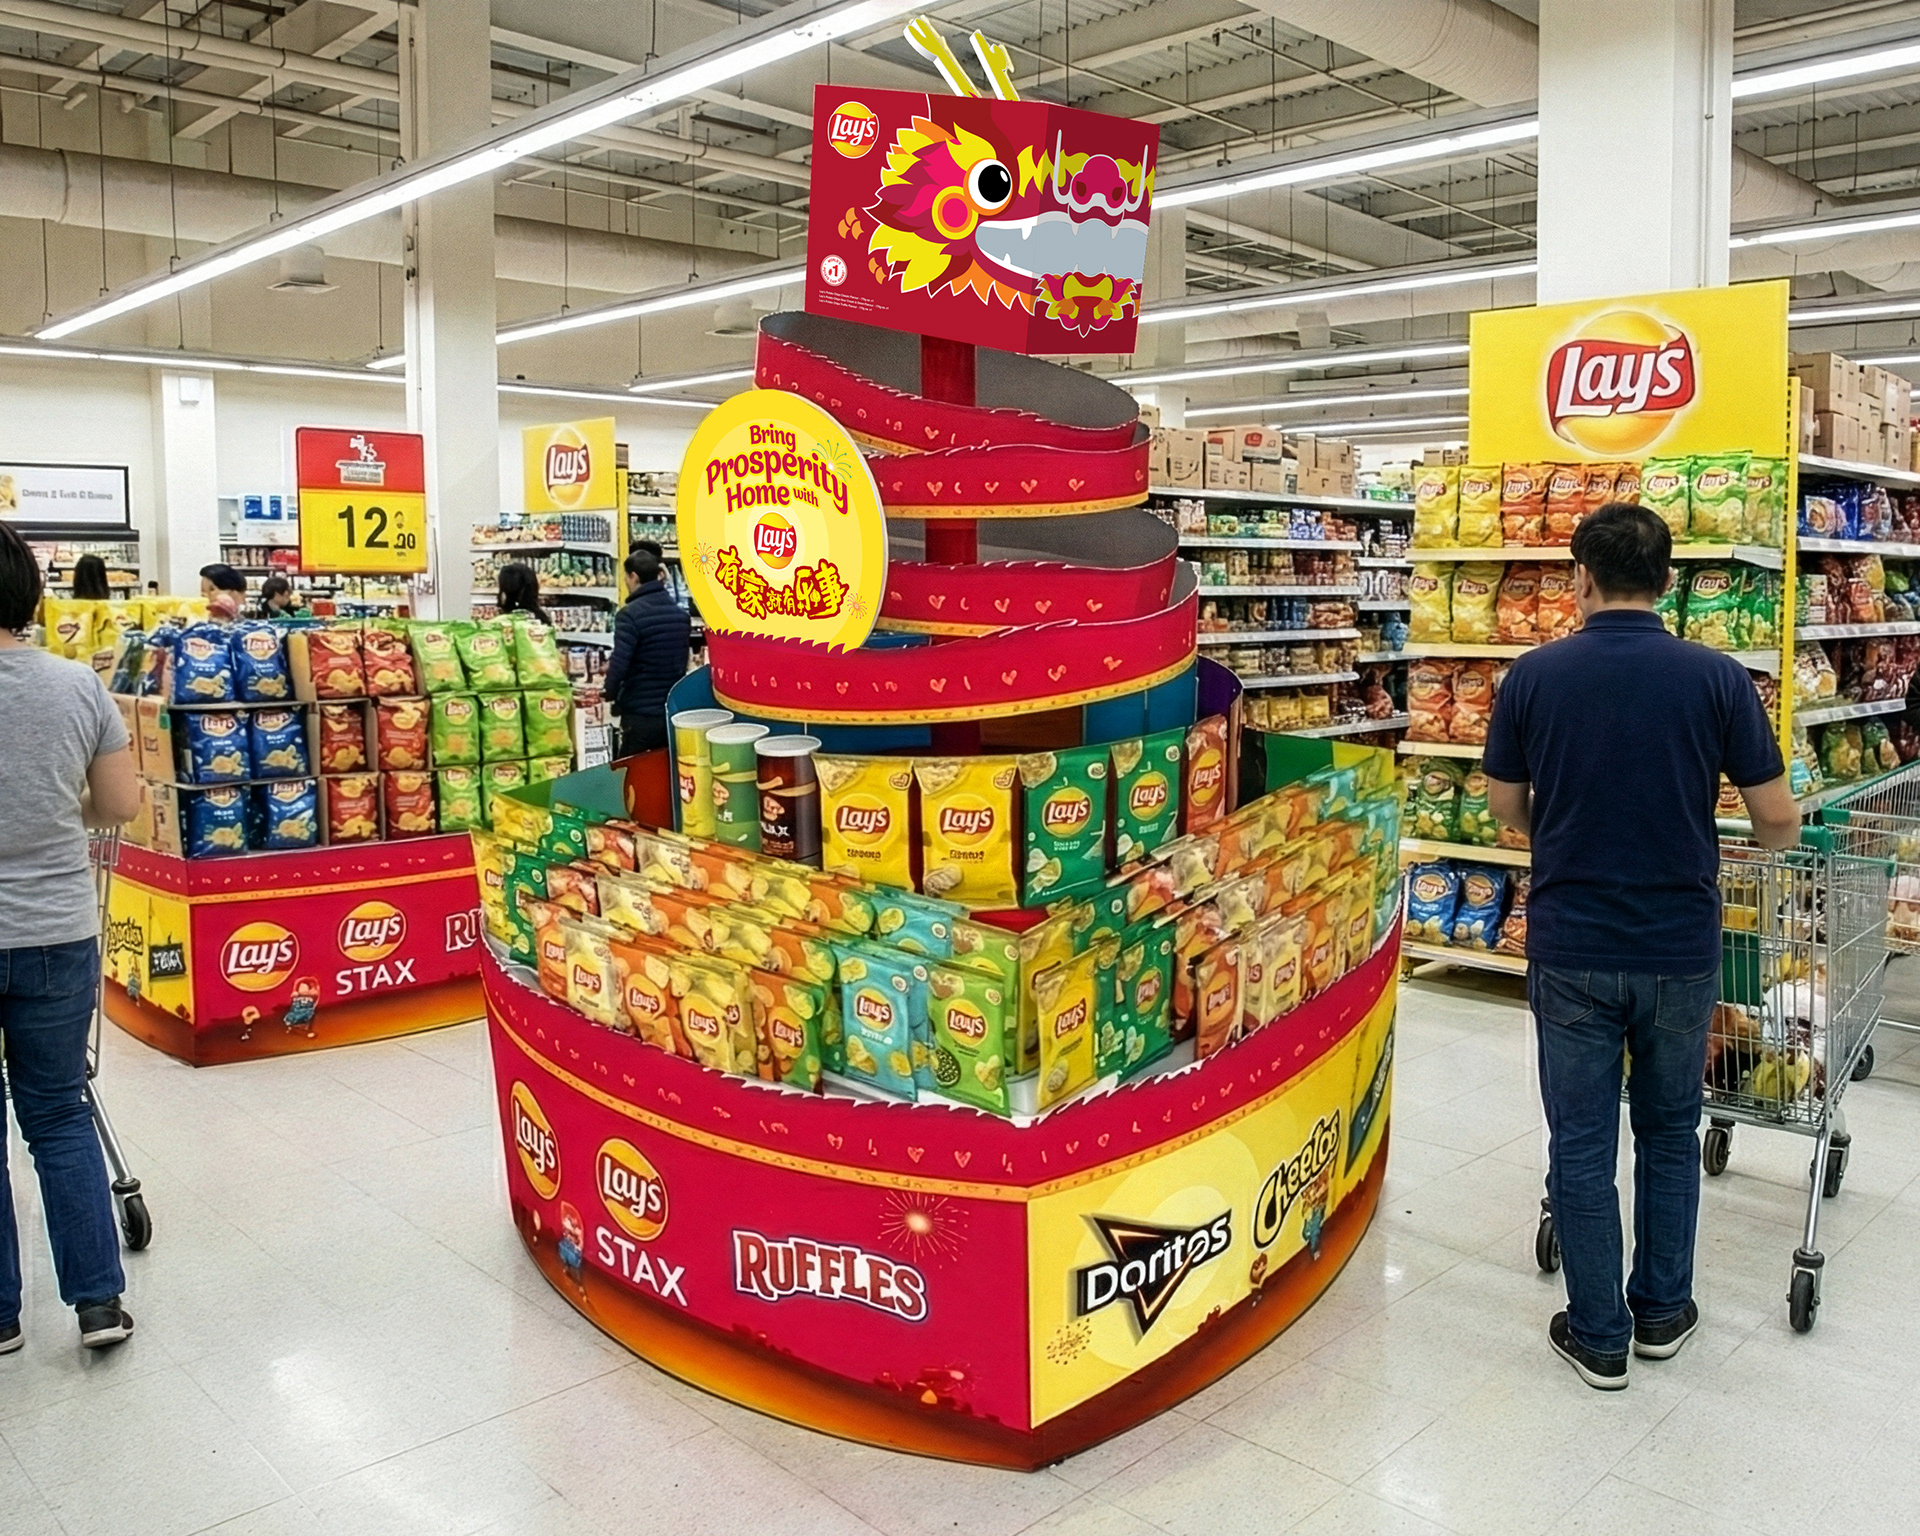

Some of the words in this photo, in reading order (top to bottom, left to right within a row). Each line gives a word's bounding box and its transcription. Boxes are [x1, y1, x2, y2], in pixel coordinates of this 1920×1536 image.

[831, 114, 876, 146] Lay's
[1554, 341, 1686, 418] Lay's
[749, 424, 796, 452] Bring
[706, 450, 849, 515] Prosperity
[726, 482, 790, 513] Home
[793, 487, 819, 508] with
[338, 505, 389, 548] 12
[757, 525, 795, 557] Lay's
[336, 958, 417, 995] STAX
[514, 1099, 556, 1174] Lay's
[1253, 1108, 1342, 1249] Cheetos
[596, 1226, 688, 1306] STAX
[732, 1229, 929, 1322] RUFFLES
[1086, 1215, 1231, 1310] Doritos
